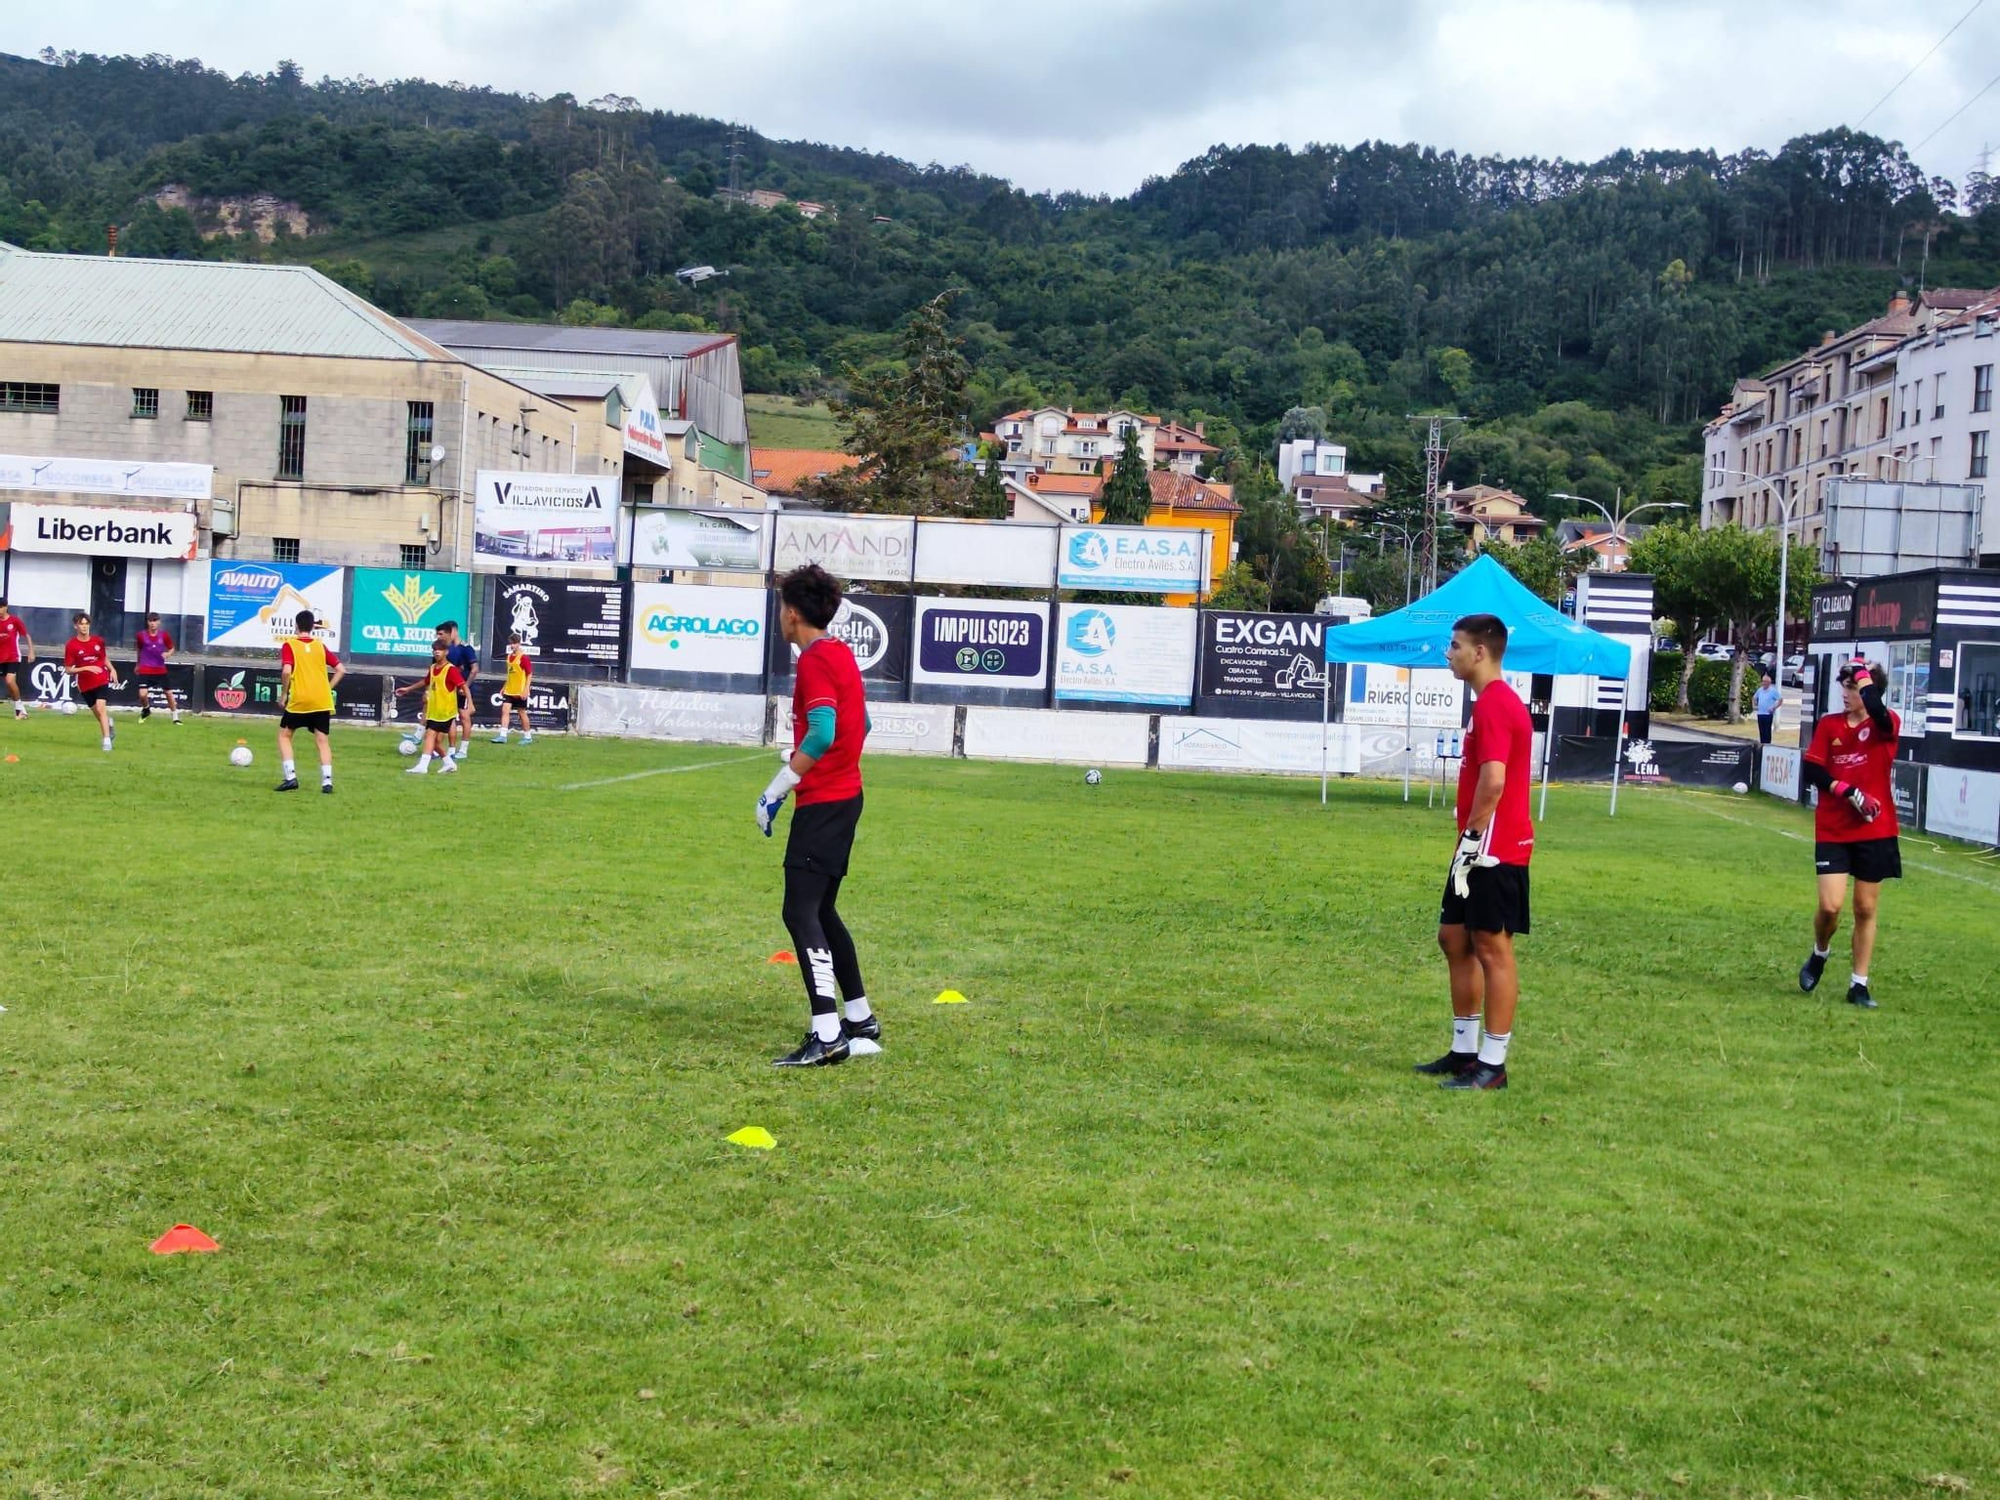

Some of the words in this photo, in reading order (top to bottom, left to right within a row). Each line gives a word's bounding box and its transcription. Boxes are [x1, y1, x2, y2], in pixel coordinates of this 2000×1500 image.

[38, 517, 173, 545] Liberbank
[781, 527, 908, 558] AMANDI
[1116, 537, 1197, 557] E.A.S.A.
[218, 572, 280, 589] AVAUTO
[503, 584, 549, 602] SAMARTINO
[363, 625, 401, 640] CAJA
[648, 615, 760, 637] AGROLAGO
[827, 621, 874, 639] trella
[934, 617, 1030, 646] IMPULSO23
[1216, 618, 1322, 647] EXGAN
[376, 642, 391, 652] DE
[1215, 645, 1244, 655] Cuatro
[1245, 646, 1279, 656] Caminos
[1061, 661, 1118, 675] E.A.S.A.
[1220, 658, 1268, 667] EXCAVACIONES
[1228, 667, 1245, 675] OBRA
[1224, 676, 1263, 684] TRANSPORTES
[254, 683, 271, 702] la
[491, 693, 569, 710] CMELA
[638, 690, 722, 712] Helados
[1281, 690, 1316, 698] VILLAVICIOSA
[1415, 692, 1453, 707] CUETO
[655, 711, 761, 732] Valencianos
[806, 947, 837, 1000] NIKE
